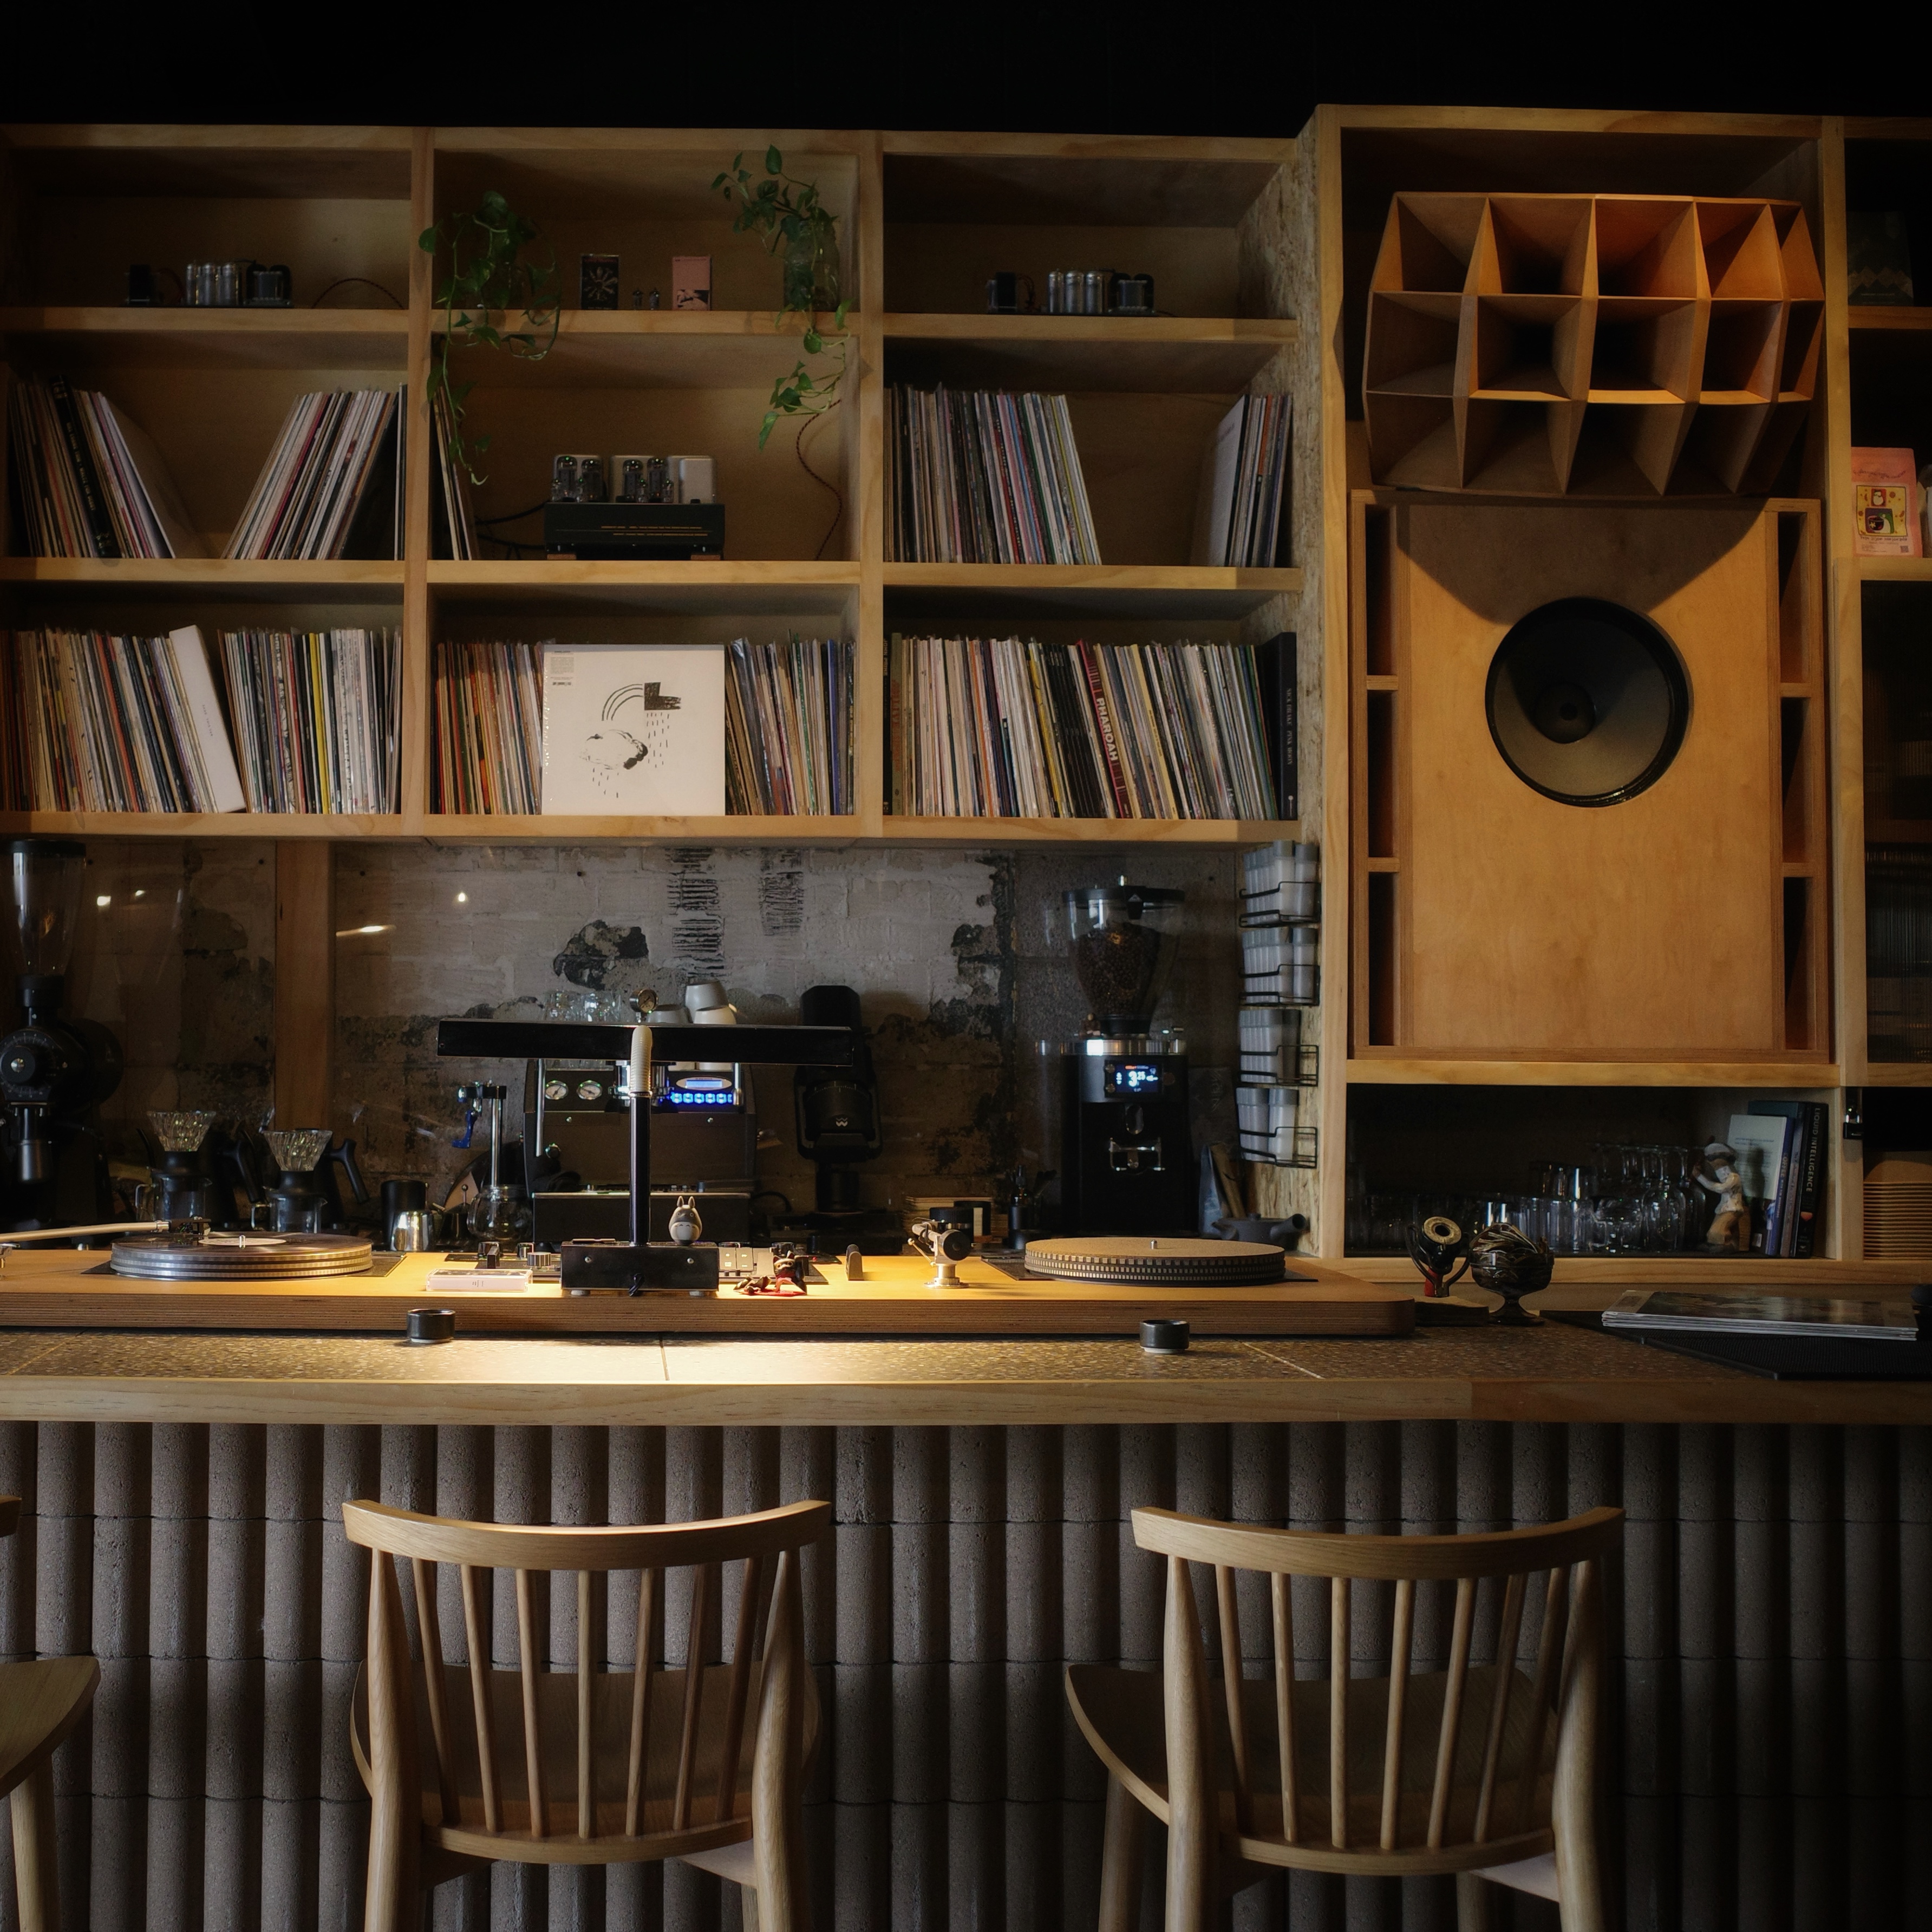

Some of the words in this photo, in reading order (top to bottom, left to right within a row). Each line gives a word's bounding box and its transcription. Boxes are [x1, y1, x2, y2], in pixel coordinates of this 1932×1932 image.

[1096, 697, 1118, 761] PHAROAH
[1812, 1107, 1821, 1135] LIQUID
[1806, 1137, 1818, 1192] INTELLIGENCE
